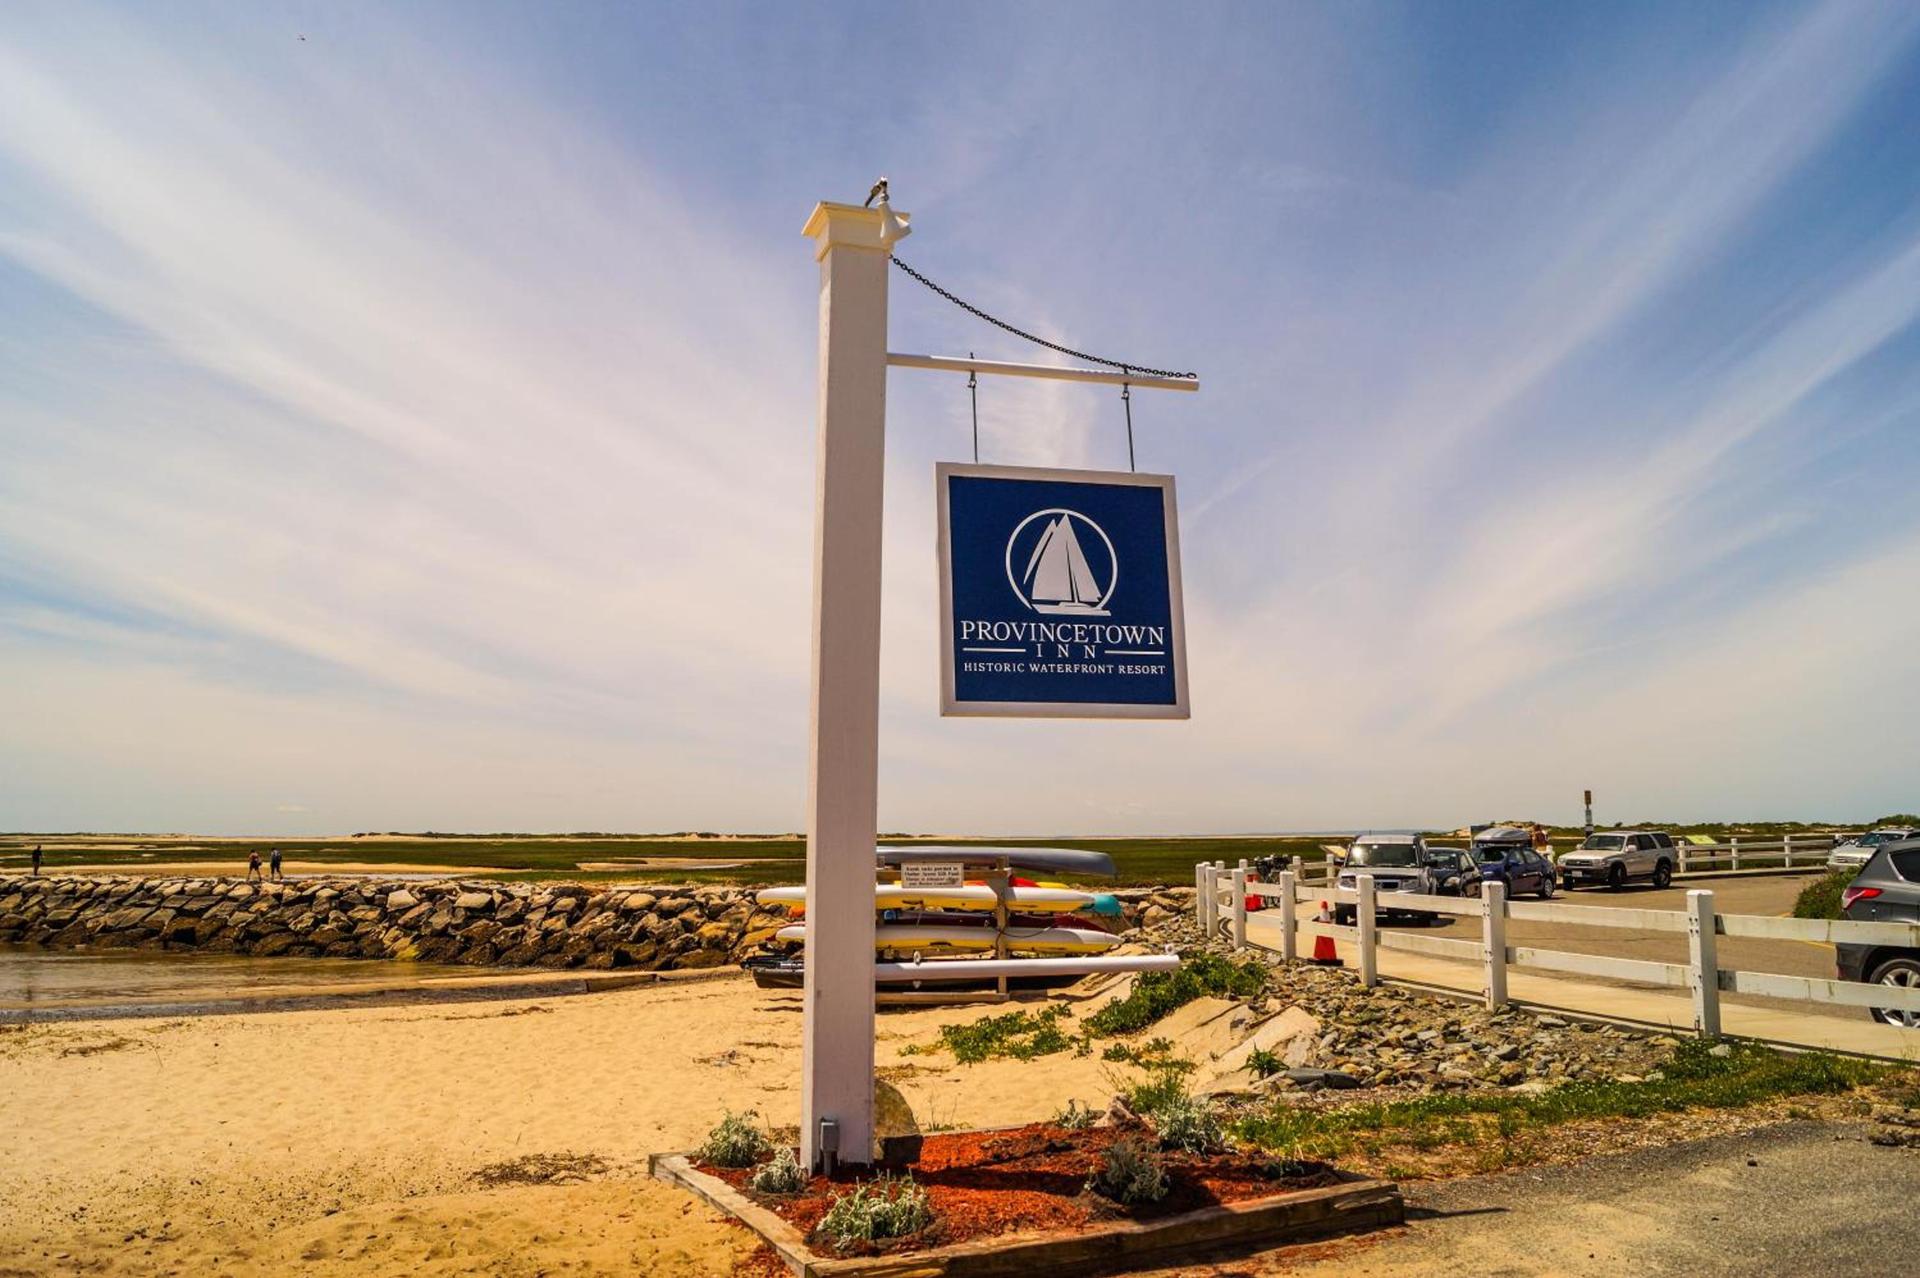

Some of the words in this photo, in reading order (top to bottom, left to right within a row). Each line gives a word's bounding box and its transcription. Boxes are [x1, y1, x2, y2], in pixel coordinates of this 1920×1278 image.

[961, 620, 1165, 645] PROVINCETOWN
[1036, 644, 1096, 658] INN
[963, 662, 1025, 673] HISTORIC
[1029, 664, 1114, 674] WATERFRONT
[1118, 665, 1166, 675] RESORT
